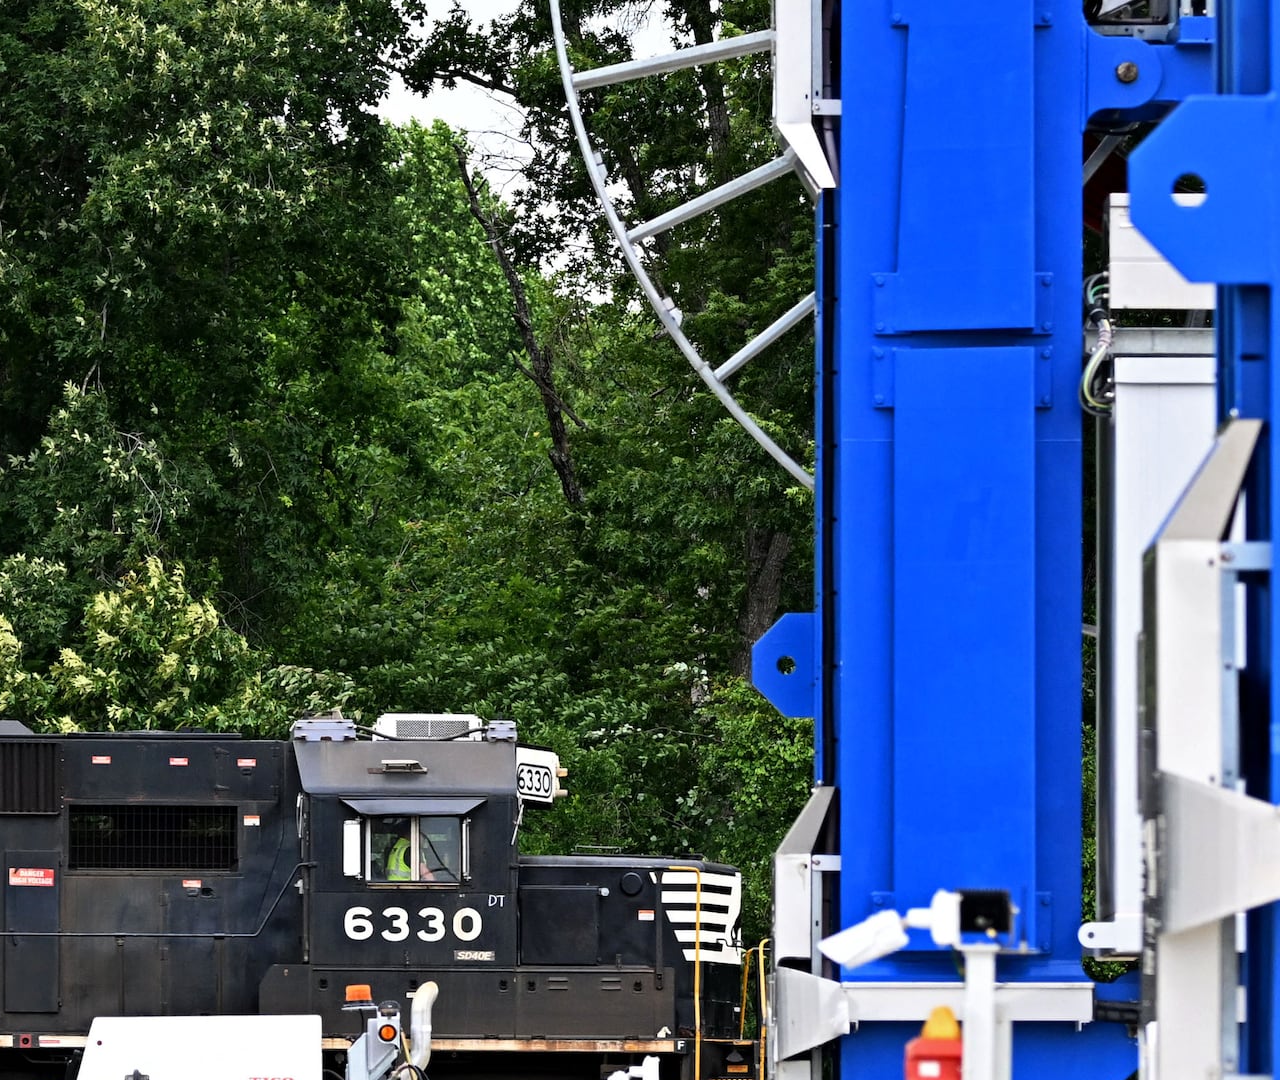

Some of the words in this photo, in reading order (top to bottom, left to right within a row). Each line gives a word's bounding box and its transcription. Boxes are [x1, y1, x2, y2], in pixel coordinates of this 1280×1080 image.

[518, 768, 551, 793] 6330
[488, 894, 505, 907] DT
[343, 906, 483, 942] 6330
[456, 951, 492, 960] SD40E
[677, 1040, 686, 1051] F
